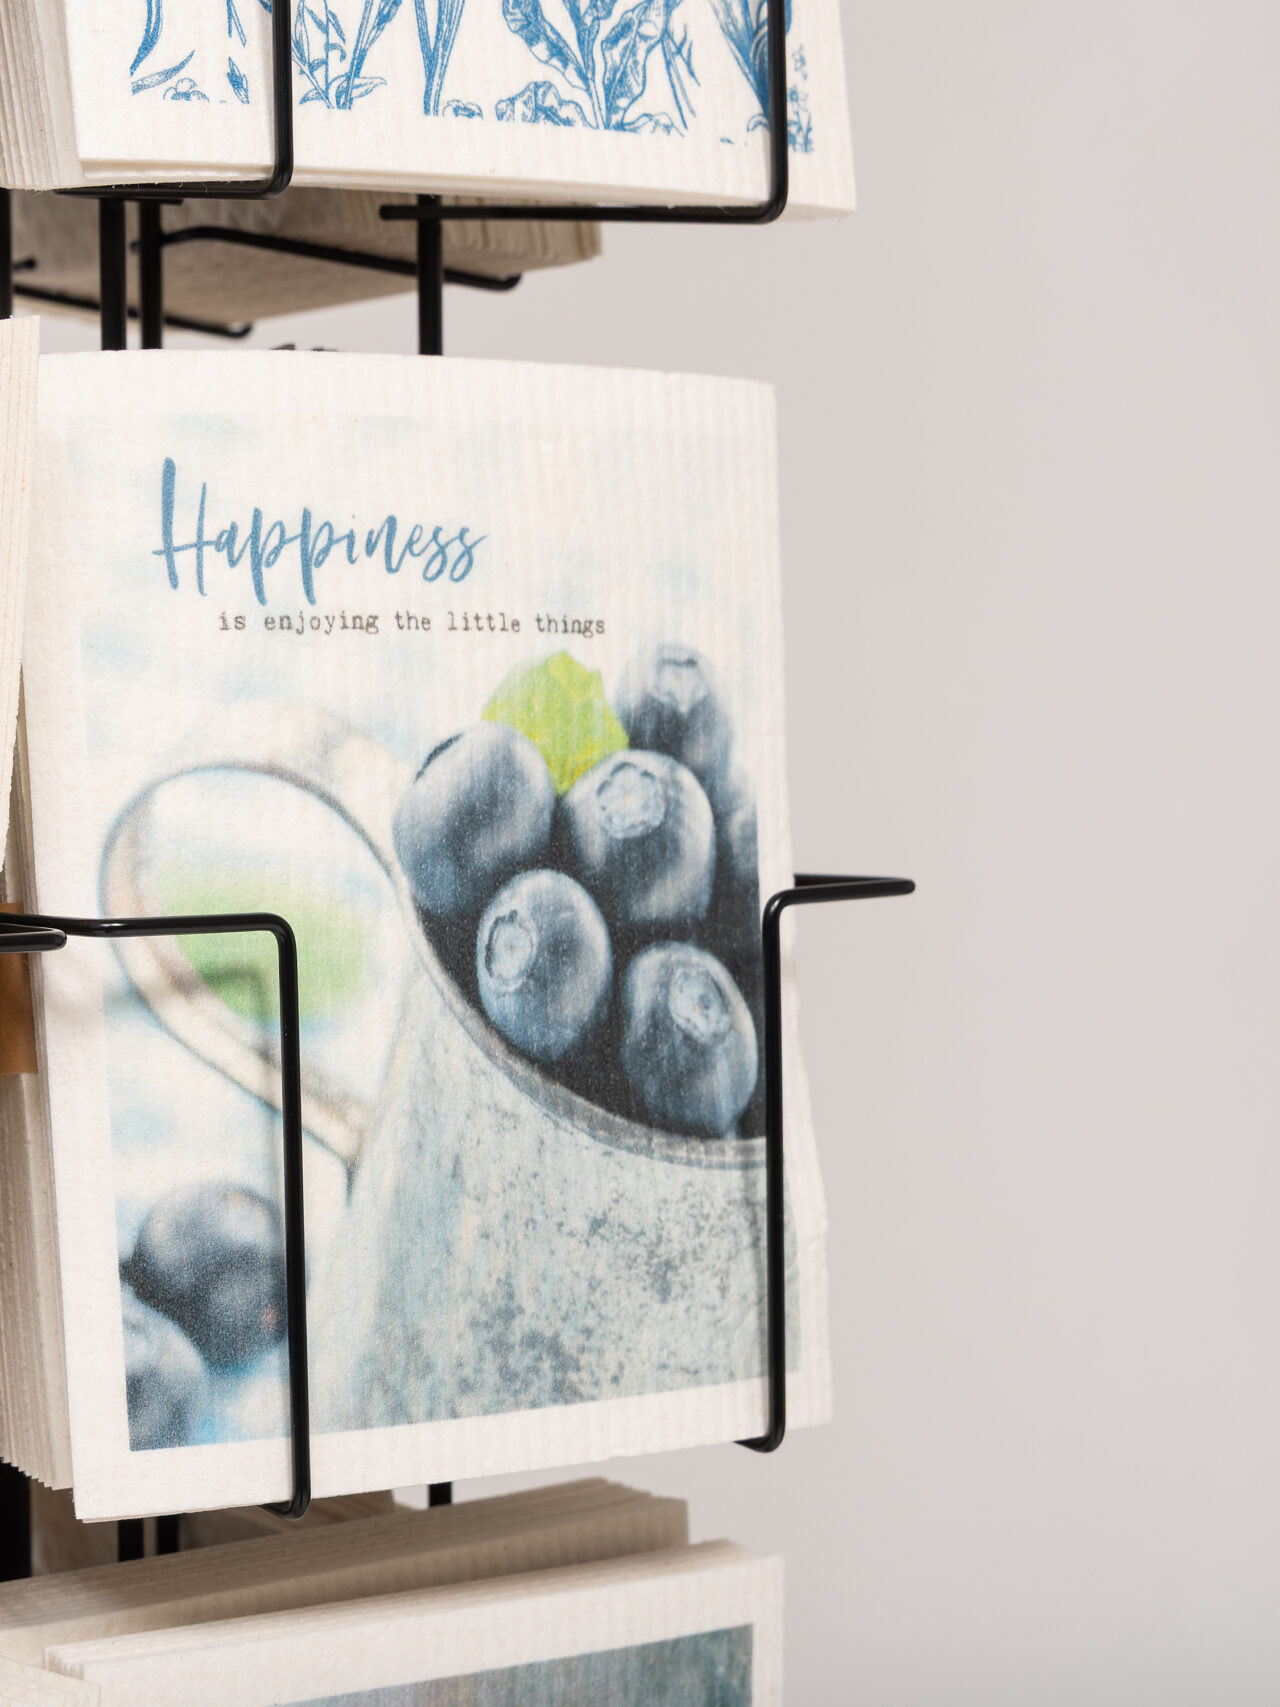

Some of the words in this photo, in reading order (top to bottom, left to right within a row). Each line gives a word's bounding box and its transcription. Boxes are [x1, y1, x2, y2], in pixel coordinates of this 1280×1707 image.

[152, 457, 488, 606] Happiness
[219, 611, 246, 631] is
[264, 612, 379, 635] enjoying
[395, 610, 431, 632] the
[447, 611, 521, 633] little
[536, 614, 605, 638] things
